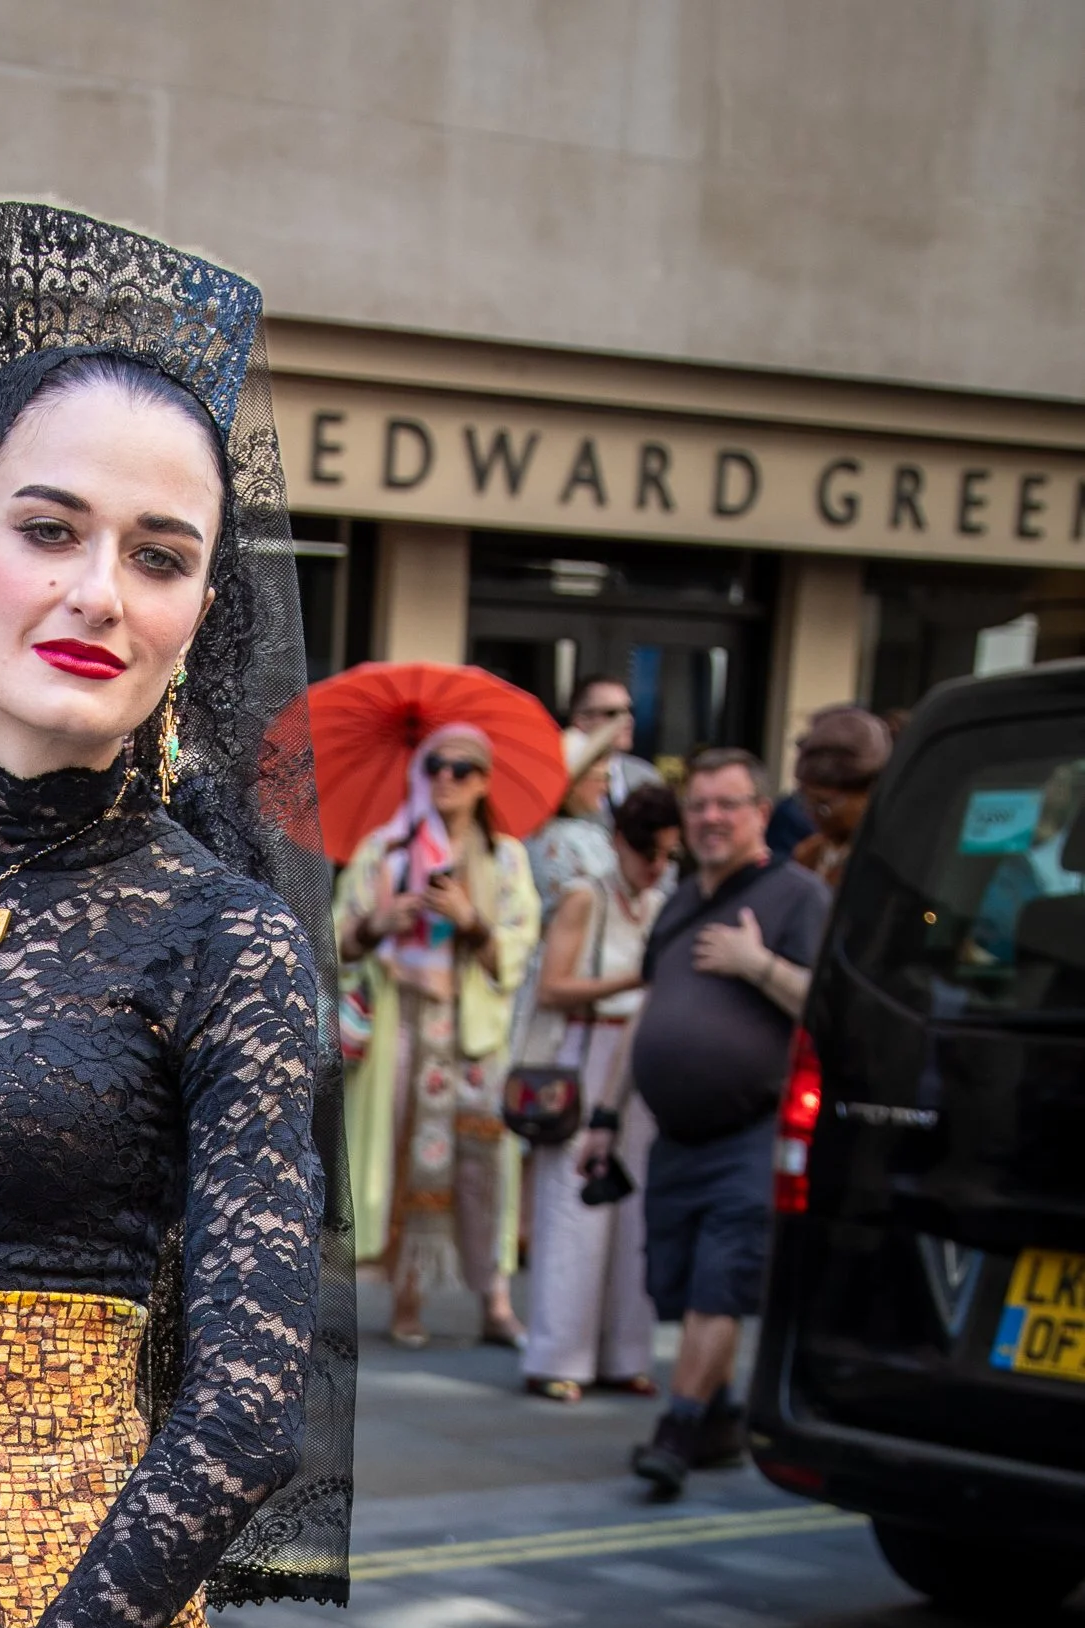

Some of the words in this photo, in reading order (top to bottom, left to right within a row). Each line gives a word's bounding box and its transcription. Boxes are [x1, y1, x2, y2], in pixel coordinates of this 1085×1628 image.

[309, 412, 762, 518] EDWARD
[1025, 1255, 1085, 1307] LK
[1025, 1316, 1085, 1368] OF
